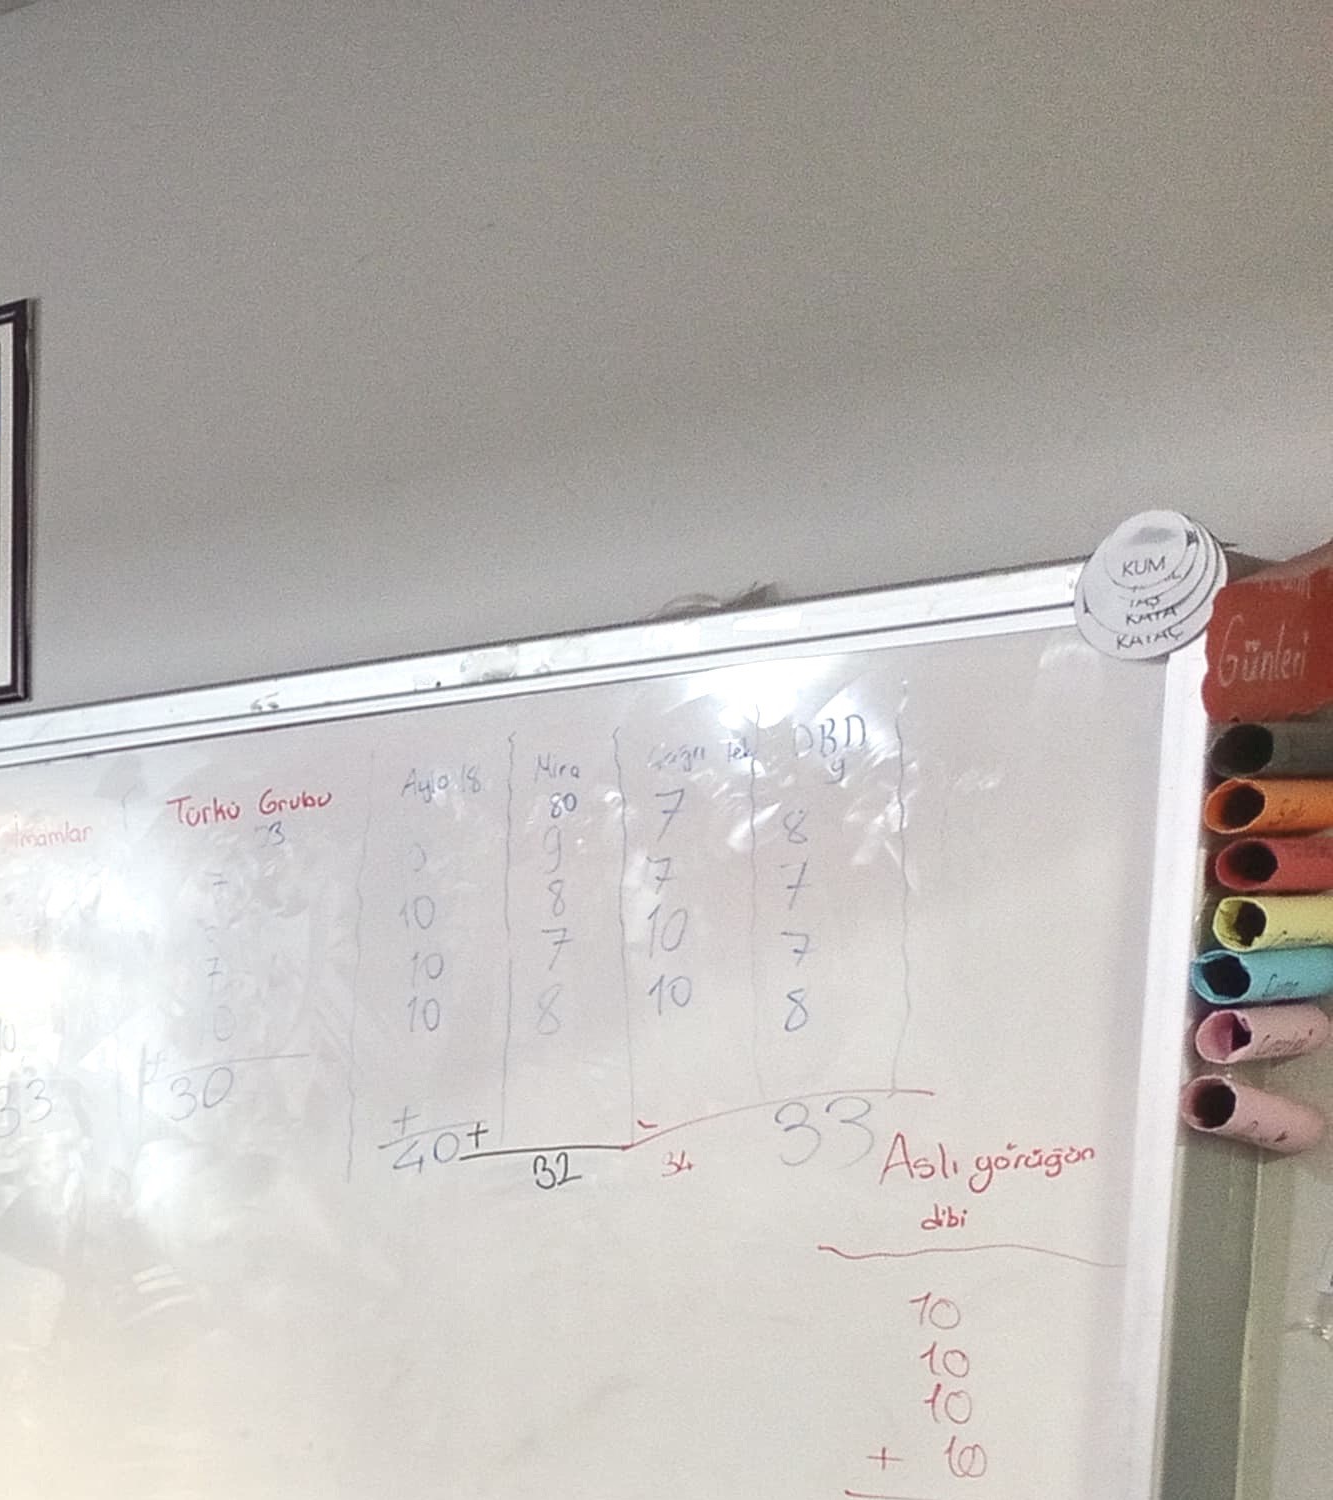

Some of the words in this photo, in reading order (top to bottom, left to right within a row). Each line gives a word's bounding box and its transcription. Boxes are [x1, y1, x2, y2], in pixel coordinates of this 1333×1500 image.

[1122, 555, 1166, 578] KUM
[258, 787, 333, 816] Grubu
[655, 788, 685, 843] 7
[398, 894, 435, 930] 10
[547, 878, 566, 917] 8
[541, 927, 573, 971] 7
[647, 904, 689, 960] 10
[781, 931, 813, 967] 7
[409, 951, 445, 989] 10
[406, 994, 441, 1032] 10
[536, 983, 565, 1036] 8
[647, 973, 693, 1017] 10
[783, 986, 809, 1033] 8
[170, 1065, 234, 1122] 30
[391, 1131, 461, 1175] 40
[773, 1095, 876, 1170] 33
[879, 1131, 958, 1186] Aslı
[920, 1203, 968, 1230] dibi
[908, 1291, 961, 1330] 10
[919, 1341, 970, 1379] 10
[924, 1382, 973, 1425] 10
